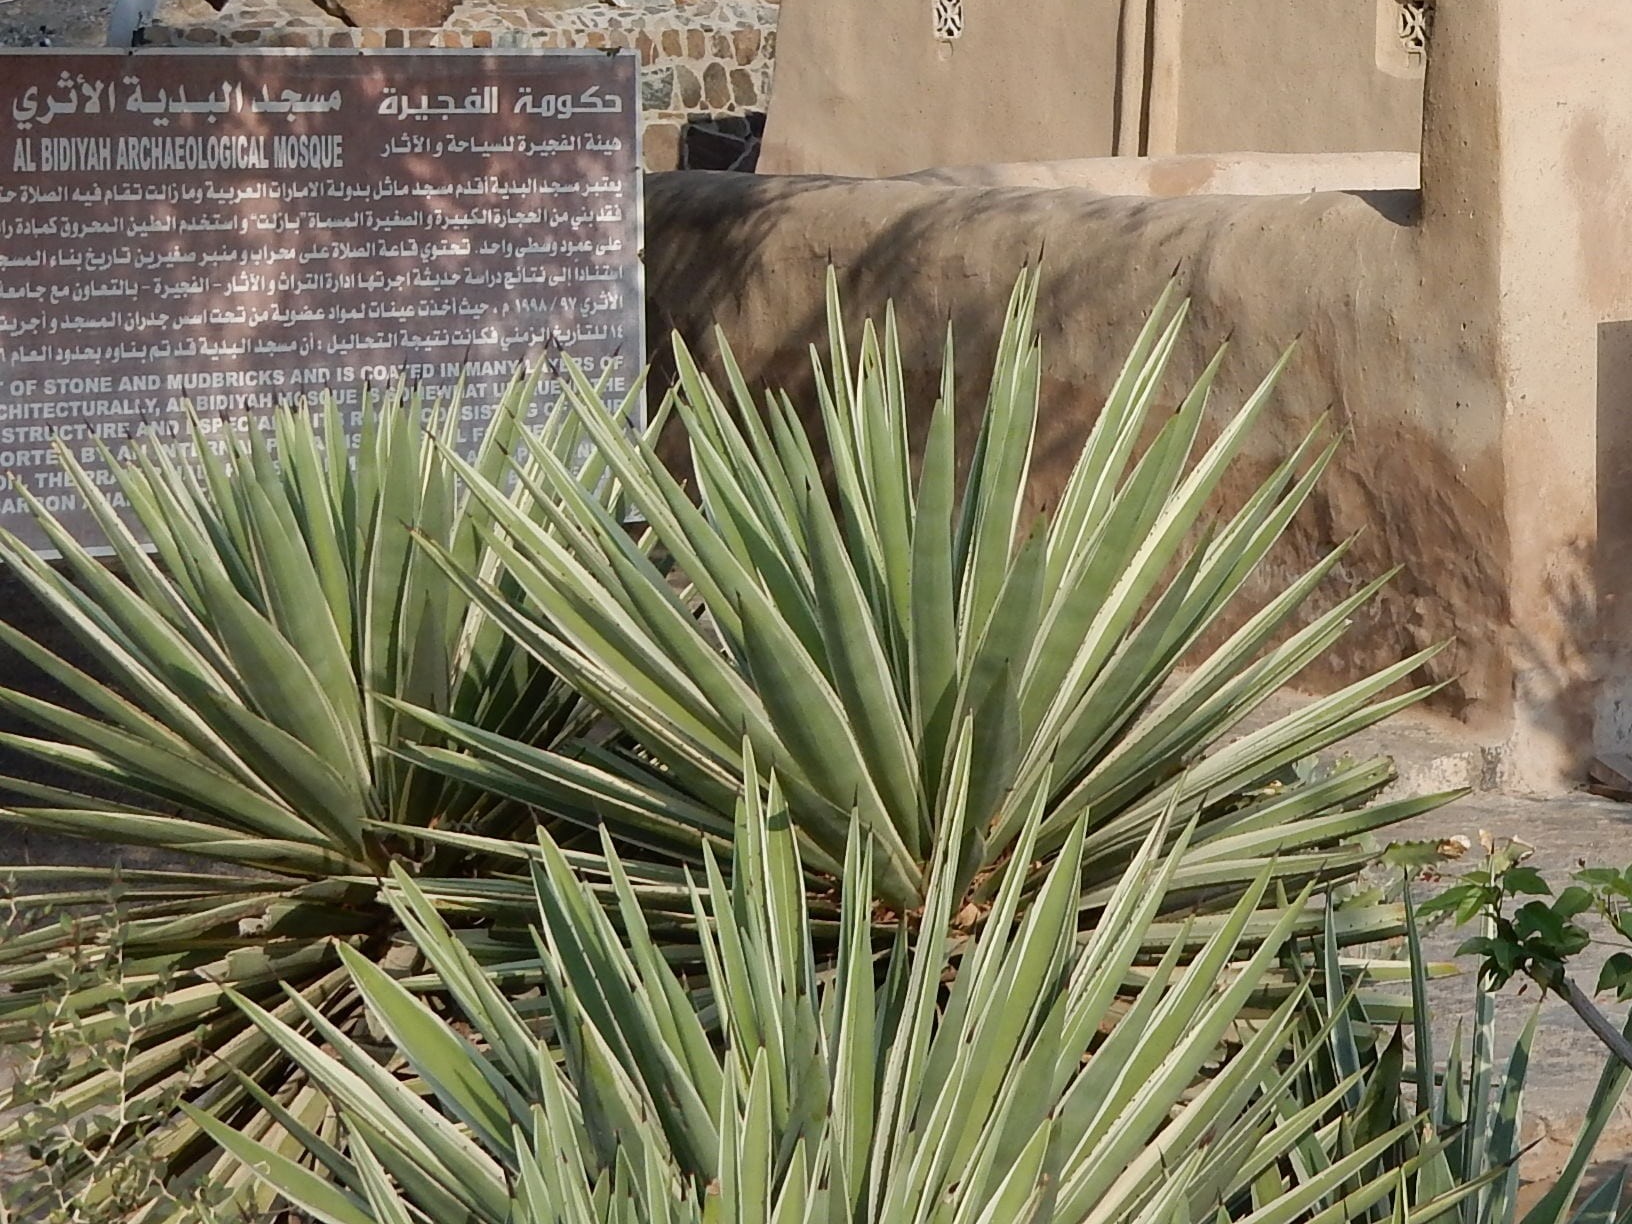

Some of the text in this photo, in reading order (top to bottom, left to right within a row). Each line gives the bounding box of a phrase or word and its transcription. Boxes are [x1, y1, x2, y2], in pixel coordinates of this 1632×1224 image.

[13, 70, 342, 130] مسجد البدية الأثري
[378, 85, 622, 121] حكومة الفجيرة
[13, 134, 344, 172] AL BIDIYAH ARCHAEOLOGICAL MOSQUE
[447, 134, 515, 157] للسياحة
[517, 133, 581, 156] الفجيرة
[20, 185, 68, 204] الصلاة
[71, 182, 101, 206] فيه
[104, 183, 143, 205] تقام
[206, 181, 267, 205] العربية
[327, 179, 371, 203] بدولة
[412, 180, 454, 200] مسجد
[490, 176, 537, 199] البدية
[539, 179, 580, 197] مسجد
[581, 176, 622, 198] يعتبر
[434, 208, 493, 230] الكبيرة
[494, 208, 548, 228] الحجارة
[550, 208, 568, 227] من
[571, 206, 594, 230] بني
[596, 204, 622, 222] فقد
[60, 216, 124, 239] المحروق
[126, 215, 177, 237] الطين
[134, 245, 196, 268] صغيرين
[250, 244, 296, 266] محراب
[299, 243, 330, 264] على
[332, 241, 376, 259] الصلاة
[378, 238, 419, 257] قاعة
[420, 238, 471, 263] تحتوي
[595, 236, 622, 256] على
[50, 248, 82, 272] بناء
[85, 246, 131, 272] تاريخ
[153, 276, 210, 299] الفجيرة
[278, 271, 324, 295] التراث
[412, 266, 461, 292] حديثة
[463, 266, 502, 288] دراسة
[50, 284, 69, 304] مع
[72, 278, 138, 301] بالتعاون
[209, 306, 246, 324] تحت
[248, 307, 269, 327] من
[271, 303, 325, 327] عضوية
[368, 301, 415, 322] عينات
[459, 297, 489, 319] حيث
[61, 312, 122, 333] المسجد
[124, 311, 170, 332] جدران
[174, 337, 197, 356] قد
[327, 332, 397, 354] التحاليل
[400, 329, 450, 352] نتيجة
[451, 326, 499, 346] فكانت
[11, 345, 52, 367] العام
[56, 344, 102, 365] بحدود
[150, 340, 171, 363] تم
[199, 337, 251, 361] البدية
[254, 338, 297, 357] مسجد
[10, 380, 38, 396] OF
[44, 376, 112, 395] STONE
[118, 374, 161, 391] AND
[167, 369, 285, 390] MUDBRICKS
[290, 368, 330, 384] AND
[337, 366, 354, 382] IS
[197, 392, 272, 411] BIDIYAH
